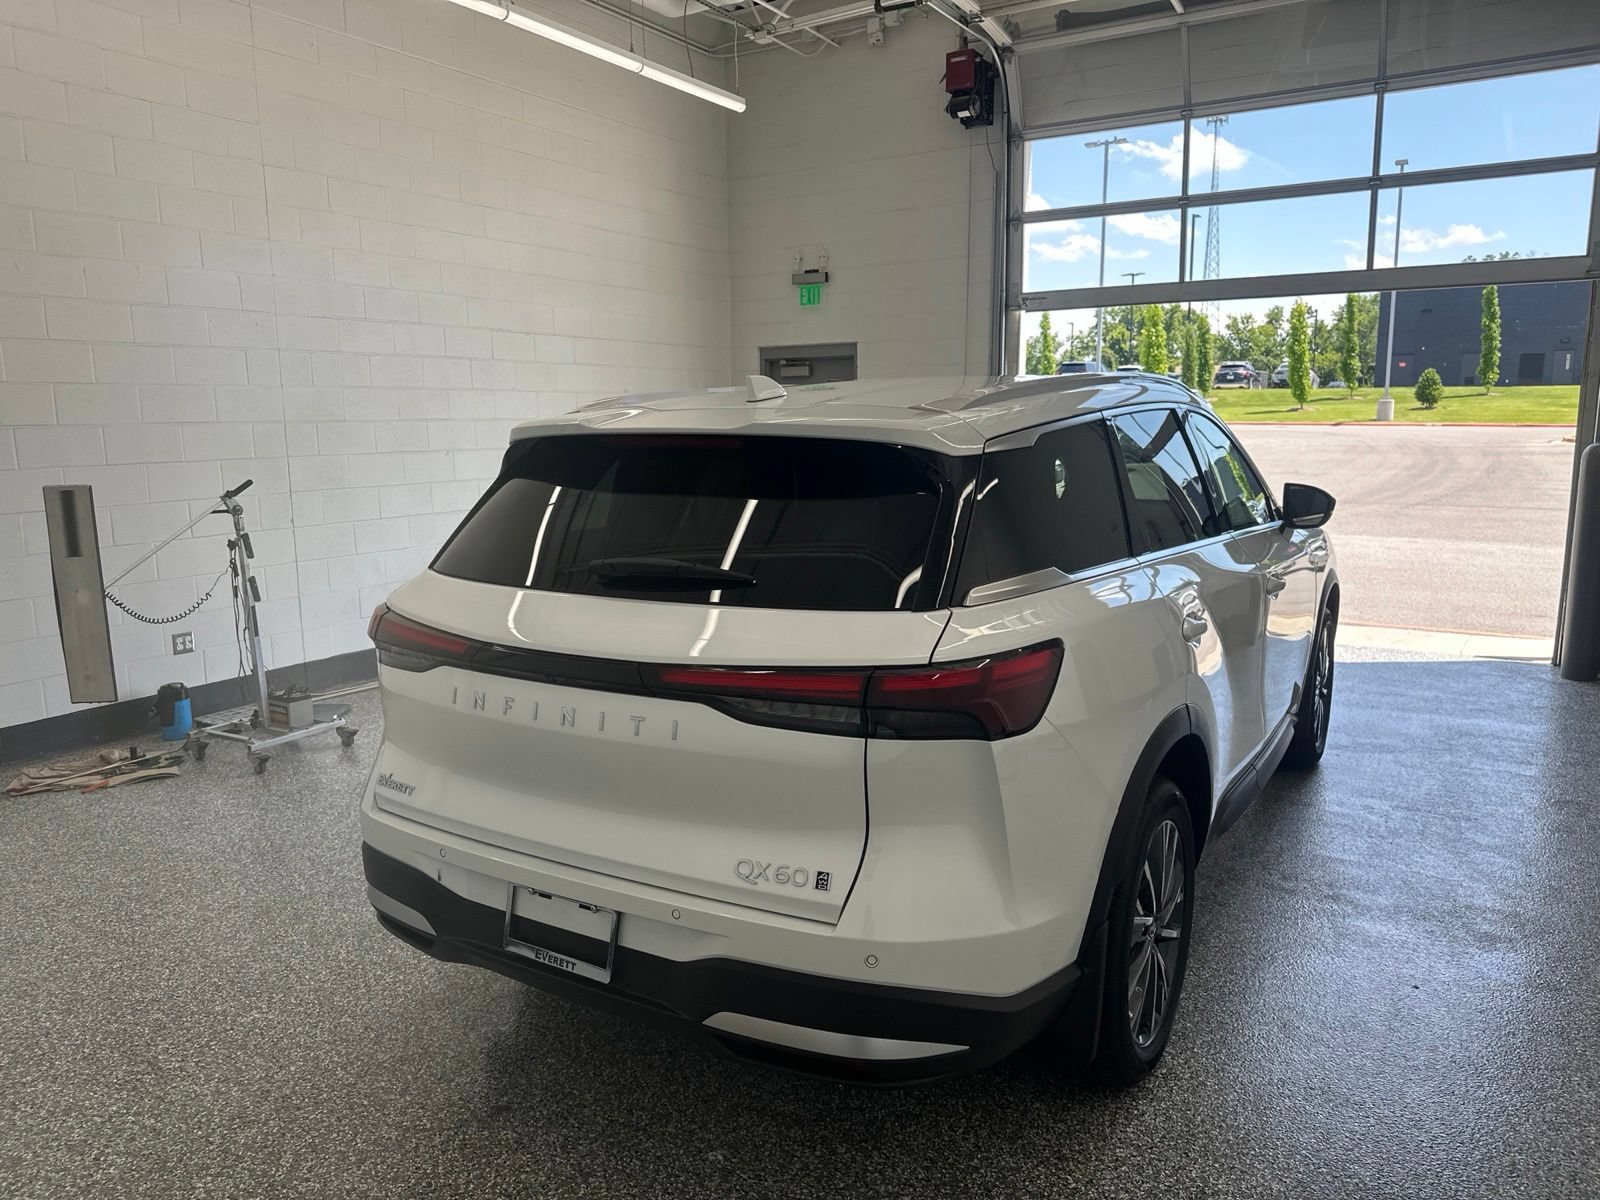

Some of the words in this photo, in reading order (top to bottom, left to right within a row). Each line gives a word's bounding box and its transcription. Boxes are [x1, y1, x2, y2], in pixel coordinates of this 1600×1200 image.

[800, 286, 822, 305] EXIT
[452, 687, 678, 740] INFINITI
[735, 858, 809, 887] QX60
[534, 949, 577, 971] EVERETT
